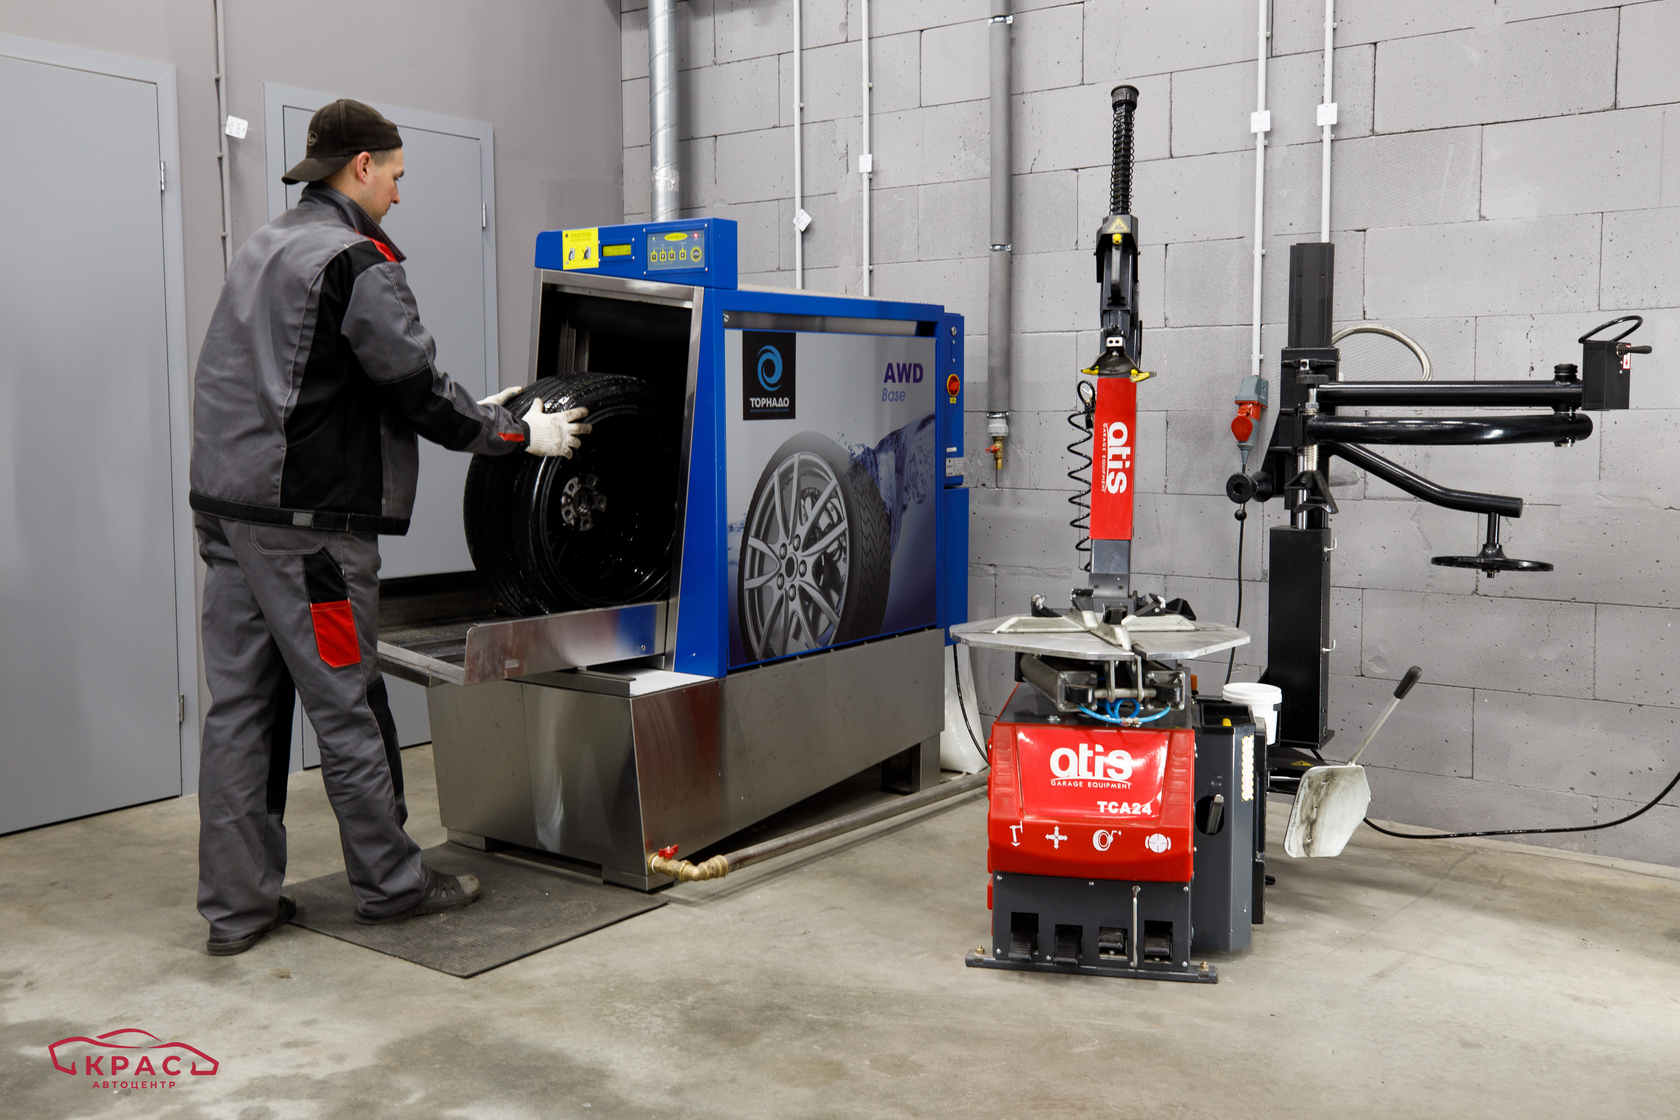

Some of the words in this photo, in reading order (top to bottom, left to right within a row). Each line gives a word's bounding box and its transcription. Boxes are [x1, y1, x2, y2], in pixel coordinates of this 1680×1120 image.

[883, 362, 924, 384] AWD
[749, 397, 790, 408] ТОРНАДО
[881, 388, 906, 402] Base
[1107, 421, 1131, 495] atis
[1050, 743, 1133, 781] atis
[1050, 780, 1084, 788] GARAGE
[1087, 781, 1132, 789] EQUIPMENT
[1096, 800, 1152, 815] TCA24
